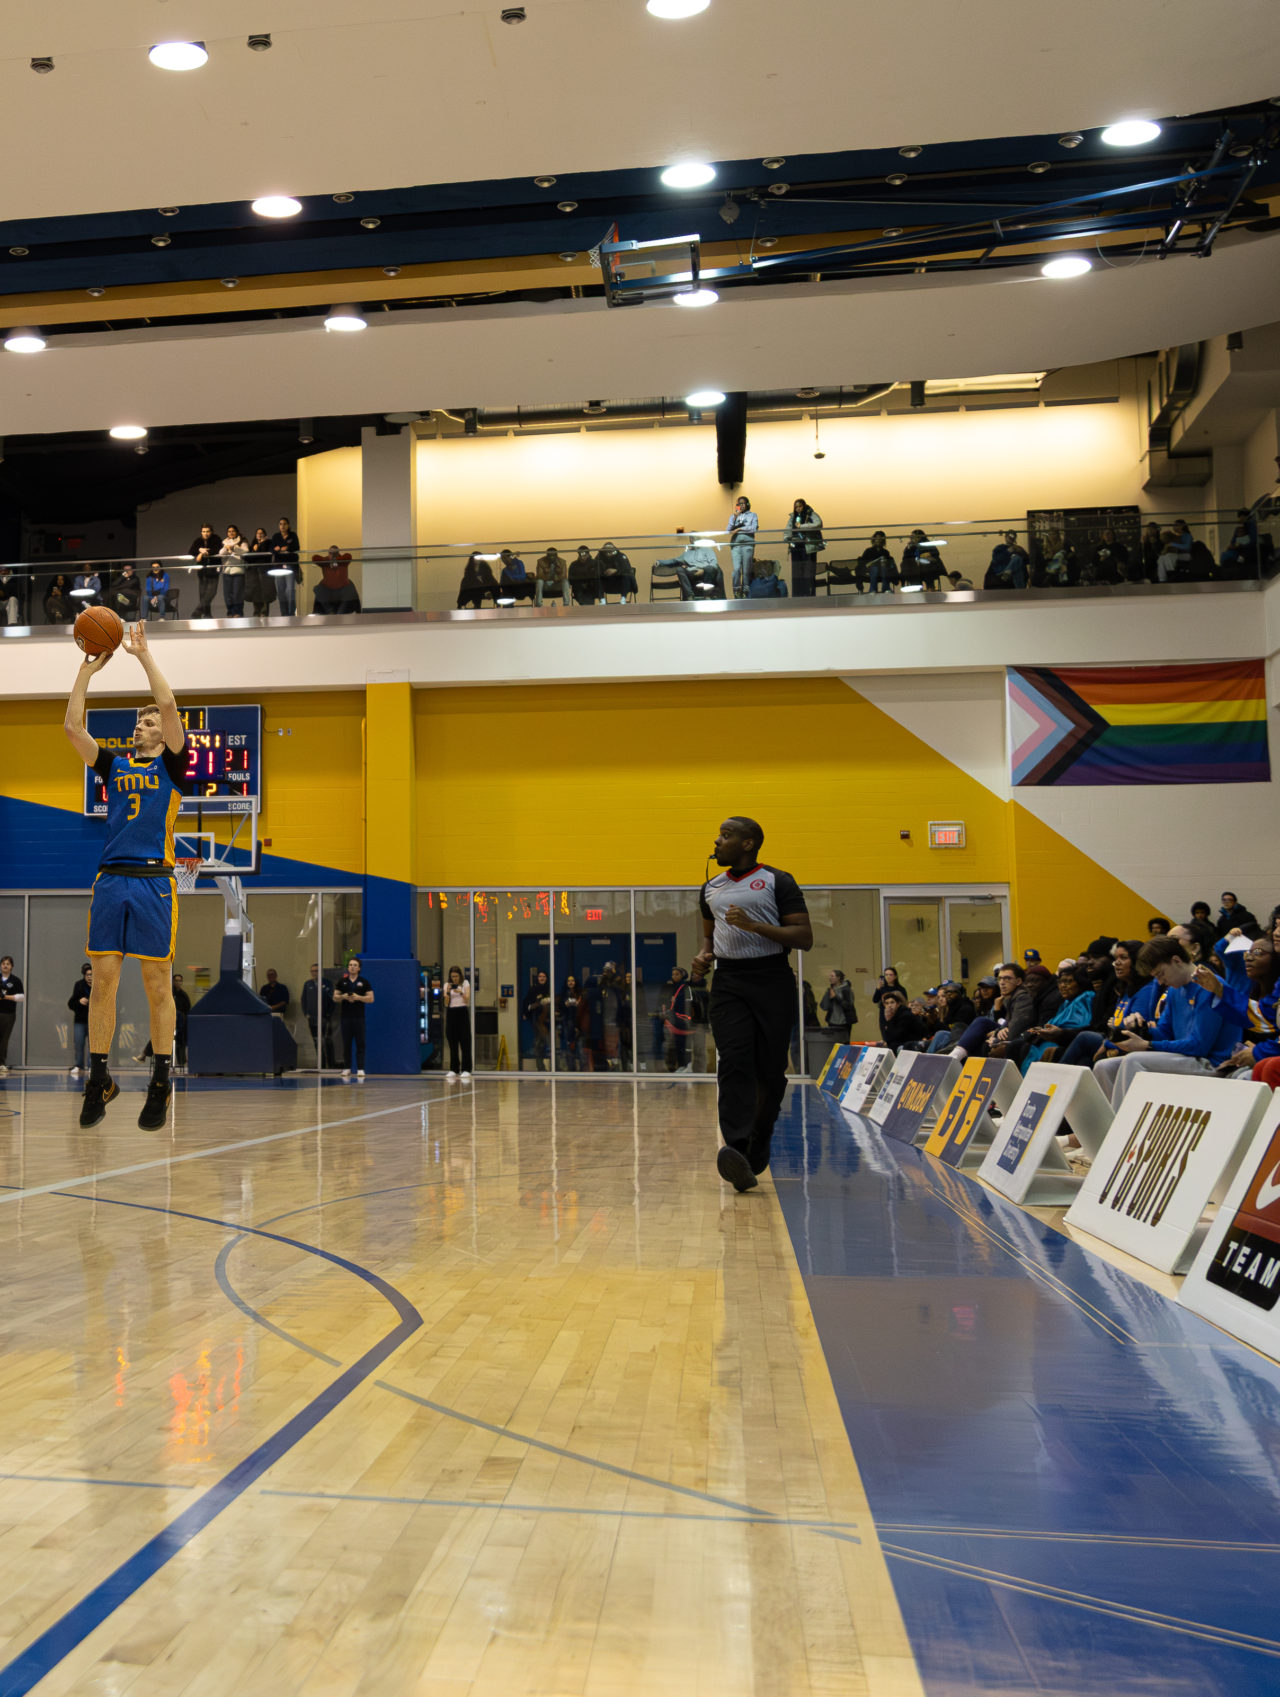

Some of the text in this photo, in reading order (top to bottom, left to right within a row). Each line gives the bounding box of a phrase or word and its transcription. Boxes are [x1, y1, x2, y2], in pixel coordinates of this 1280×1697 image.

[114, 773, 159, 792] TMU
[228, 773, 251, 781] FOULS
[127, 793, 141, 821] 3
[1222, 1240, 1280, 1288] TEAM
